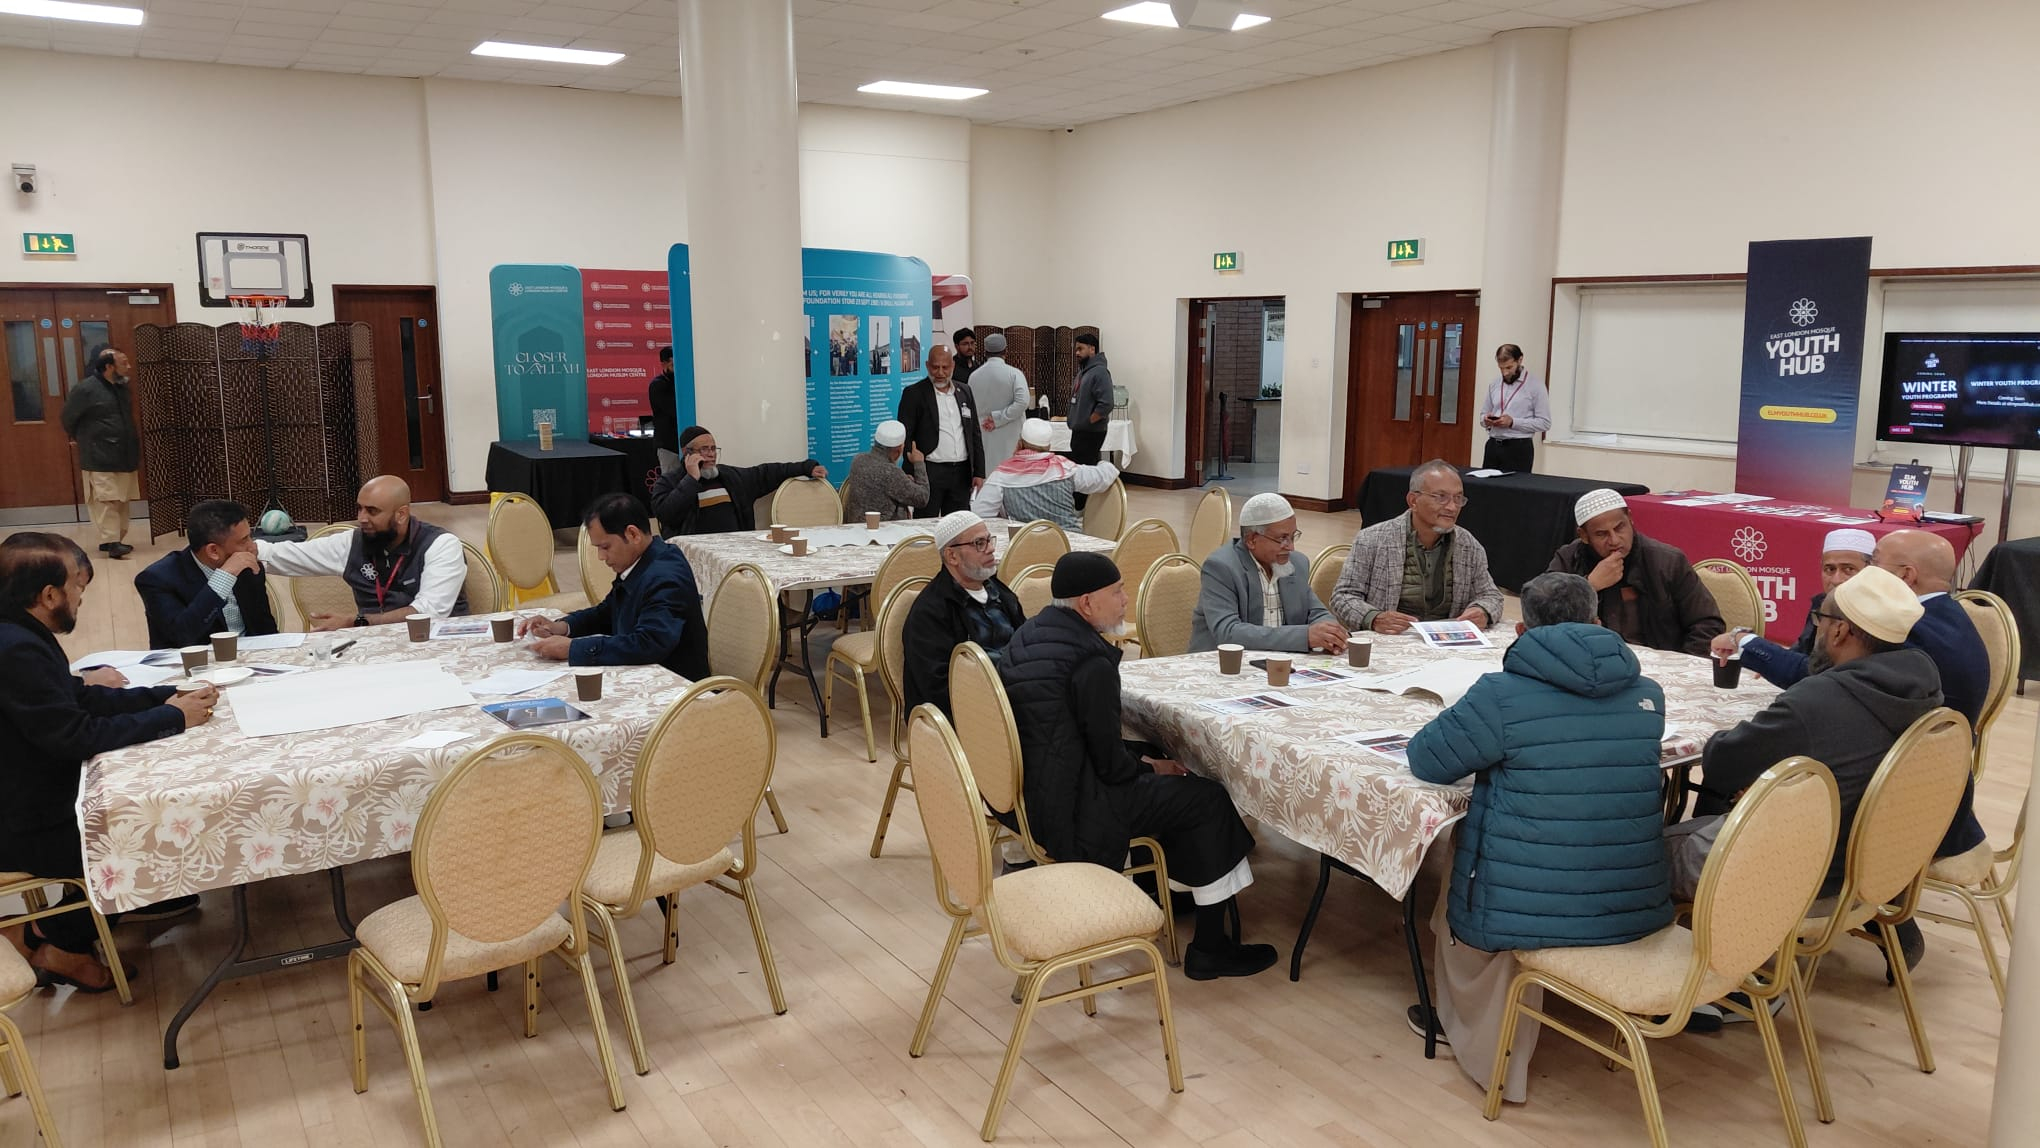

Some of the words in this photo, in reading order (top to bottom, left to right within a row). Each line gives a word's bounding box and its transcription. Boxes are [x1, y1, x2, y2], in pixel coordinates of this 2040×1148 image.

[1770, 332, 1784, 340] EAST
[1784, 329, 1810, 338] LONDON
[1810, 326, 1836, 334] MOSQUE
[1766, 333, 1841, 360] YOUTH
[515, 351, 568, 364] CLOSER
[504, 363, 525, 376] TO
[523, 362, 580, 376] ALLAH
[1779, 354, 1826, 377] HUB
[1902, 380, 1957, 393] WINTER
[1759, 566, 1791, 575] MOSQUE
[285, 954, 310, 964] LIFETIME
